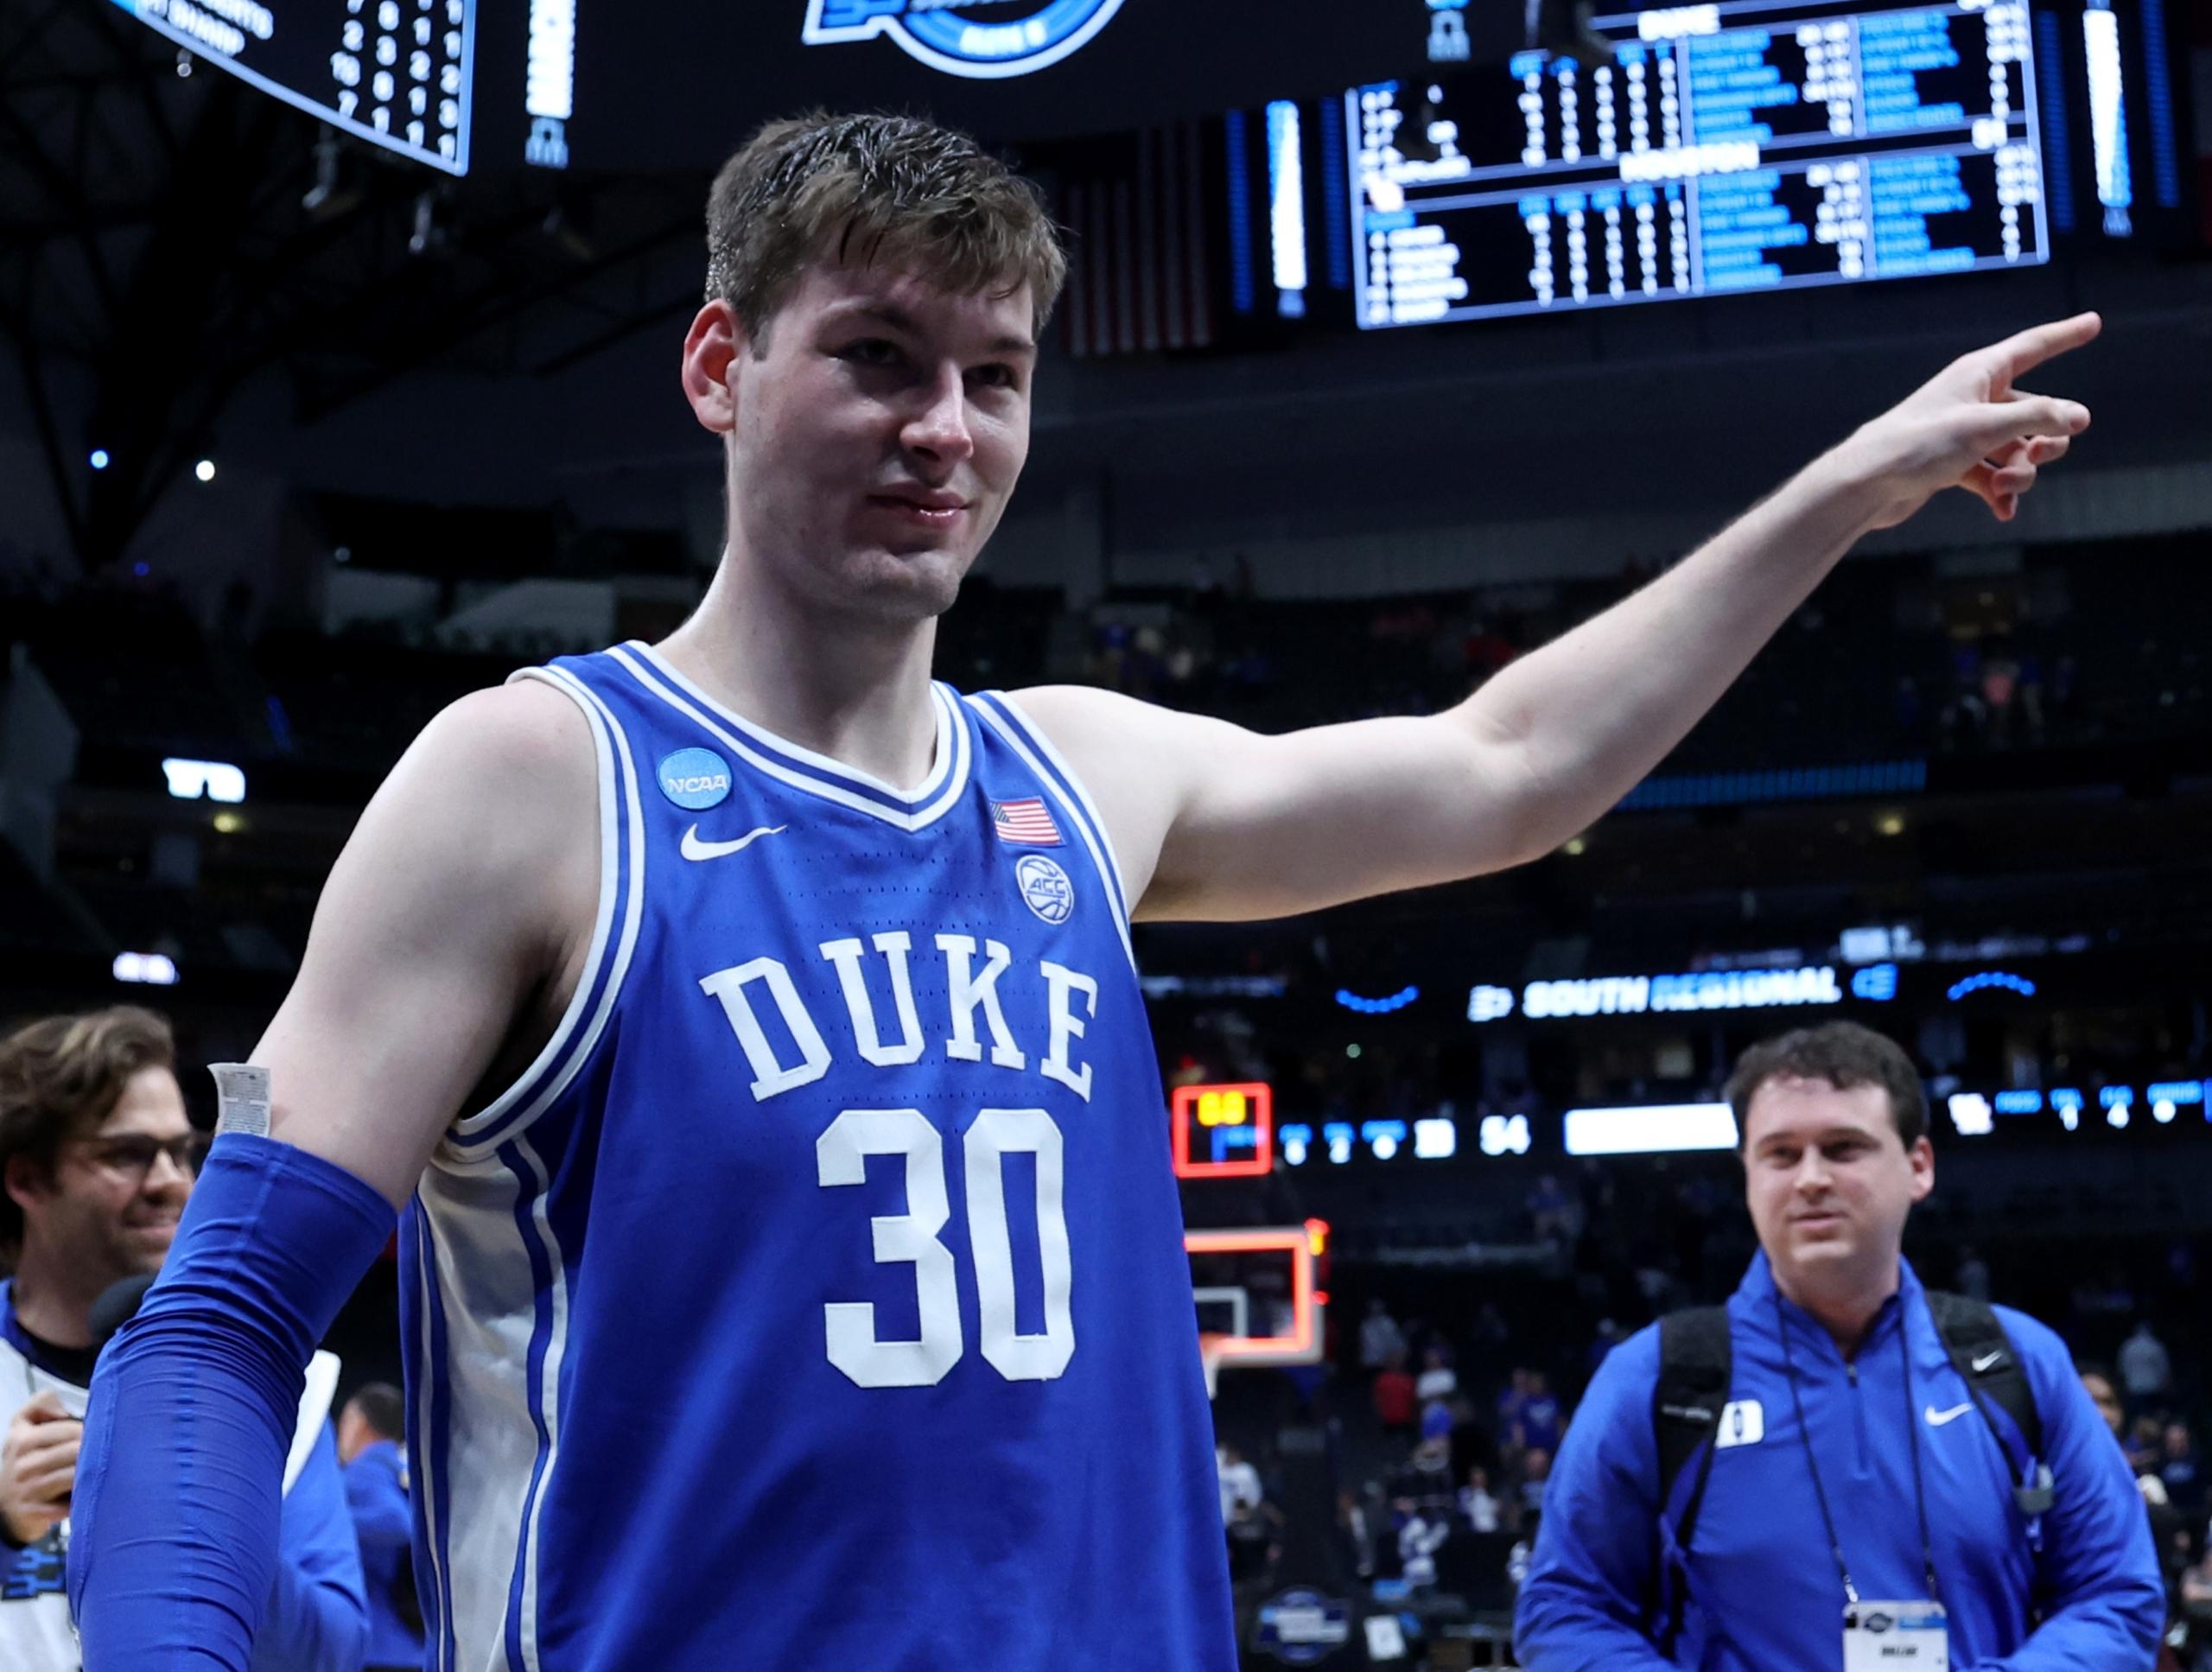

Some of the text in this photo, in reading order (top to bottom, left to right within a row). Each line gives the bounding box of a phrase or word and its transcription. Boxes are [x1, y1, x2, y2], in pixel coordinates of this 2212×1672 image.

[667, 774, 728, 793] NCAA
[1029, 877, 1065, 894] ACC
[1522, 966, 1842, 1019] SOUTH REGIONAL
[699, 931, 1097, 1103] DUKE
[1480, 1114, 1530, 1156] 54
[816, 1109, 1075, 1388] 30
